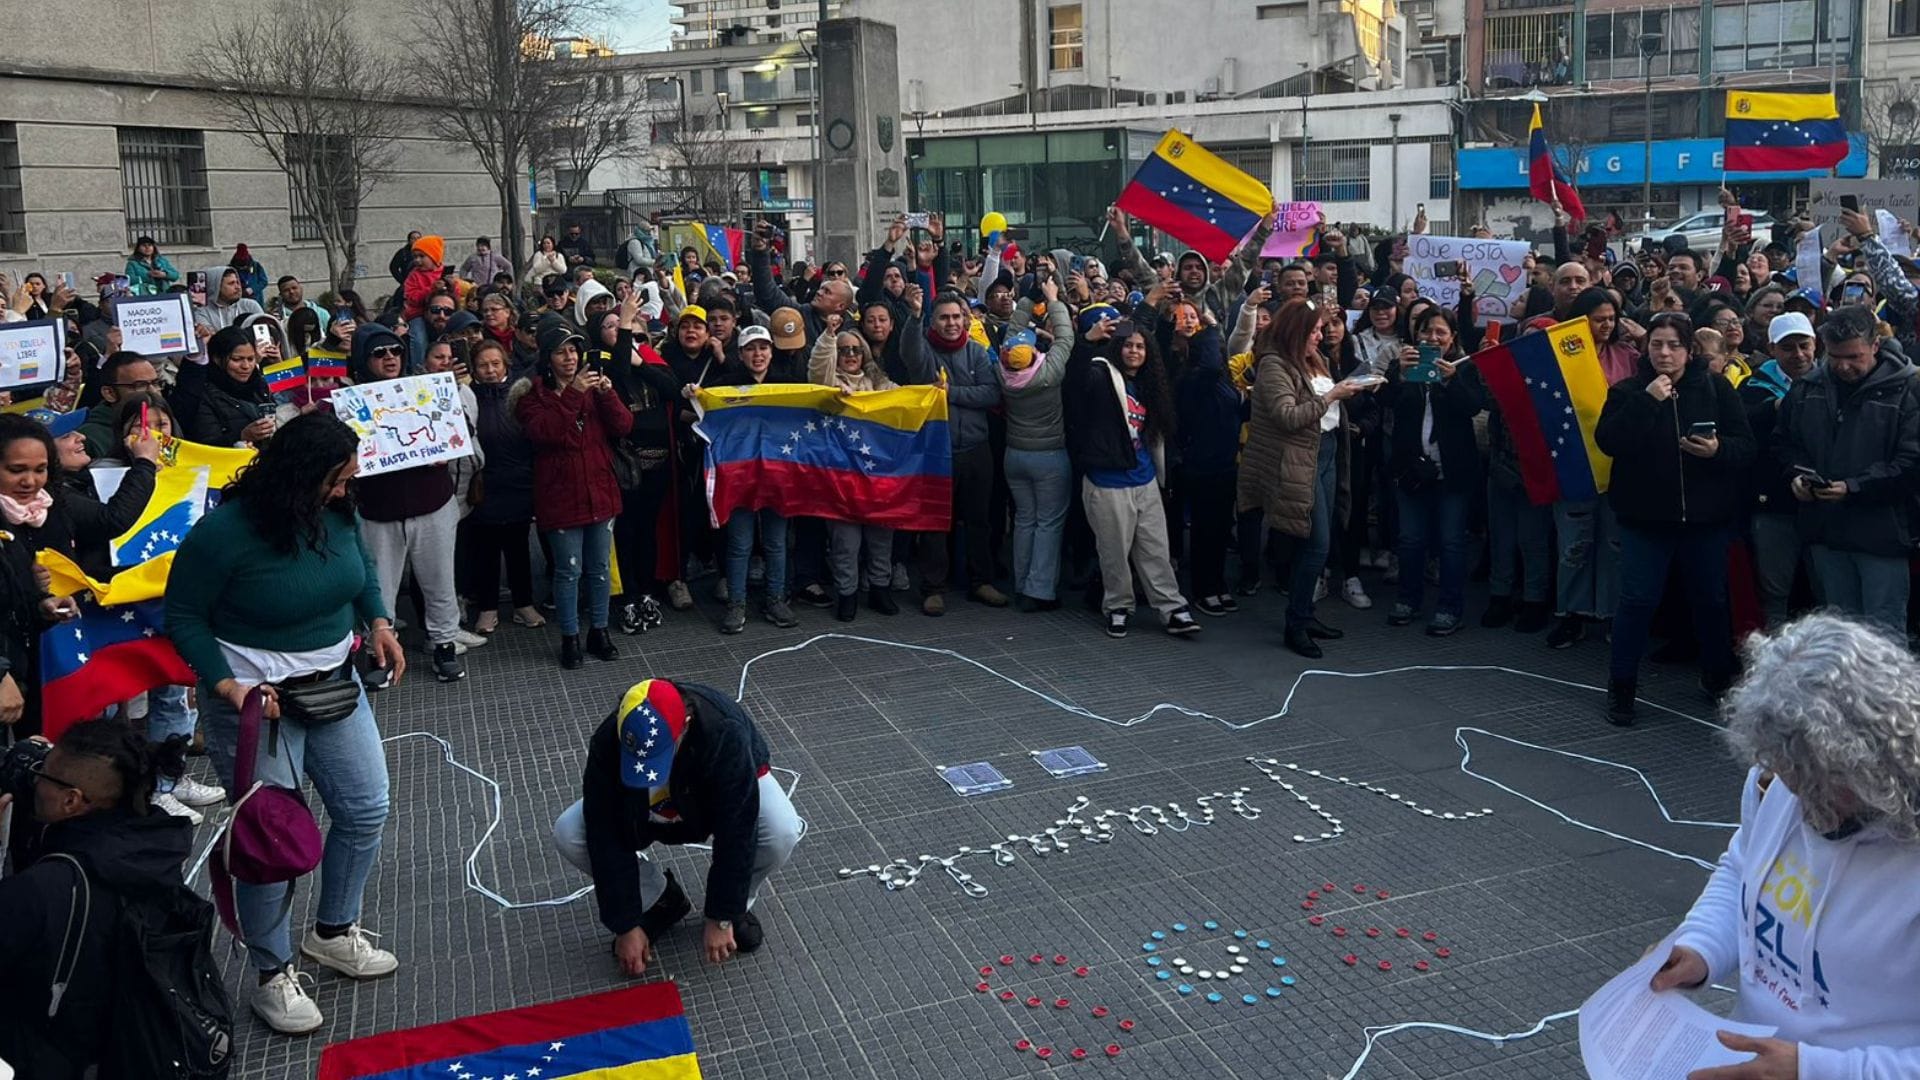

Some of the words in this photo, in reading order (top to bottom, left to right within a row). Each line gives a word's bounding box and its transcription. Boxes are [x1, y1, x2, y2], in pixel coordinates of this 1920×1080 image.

[1518, 155, 1621, 175] LNG
[1416, 237, 1451, 259] Que
[127, 307, 163, 317] MADURO
[17, 349, 38, 361] LIBRE
[379, 452, 410, 468] HASTA
